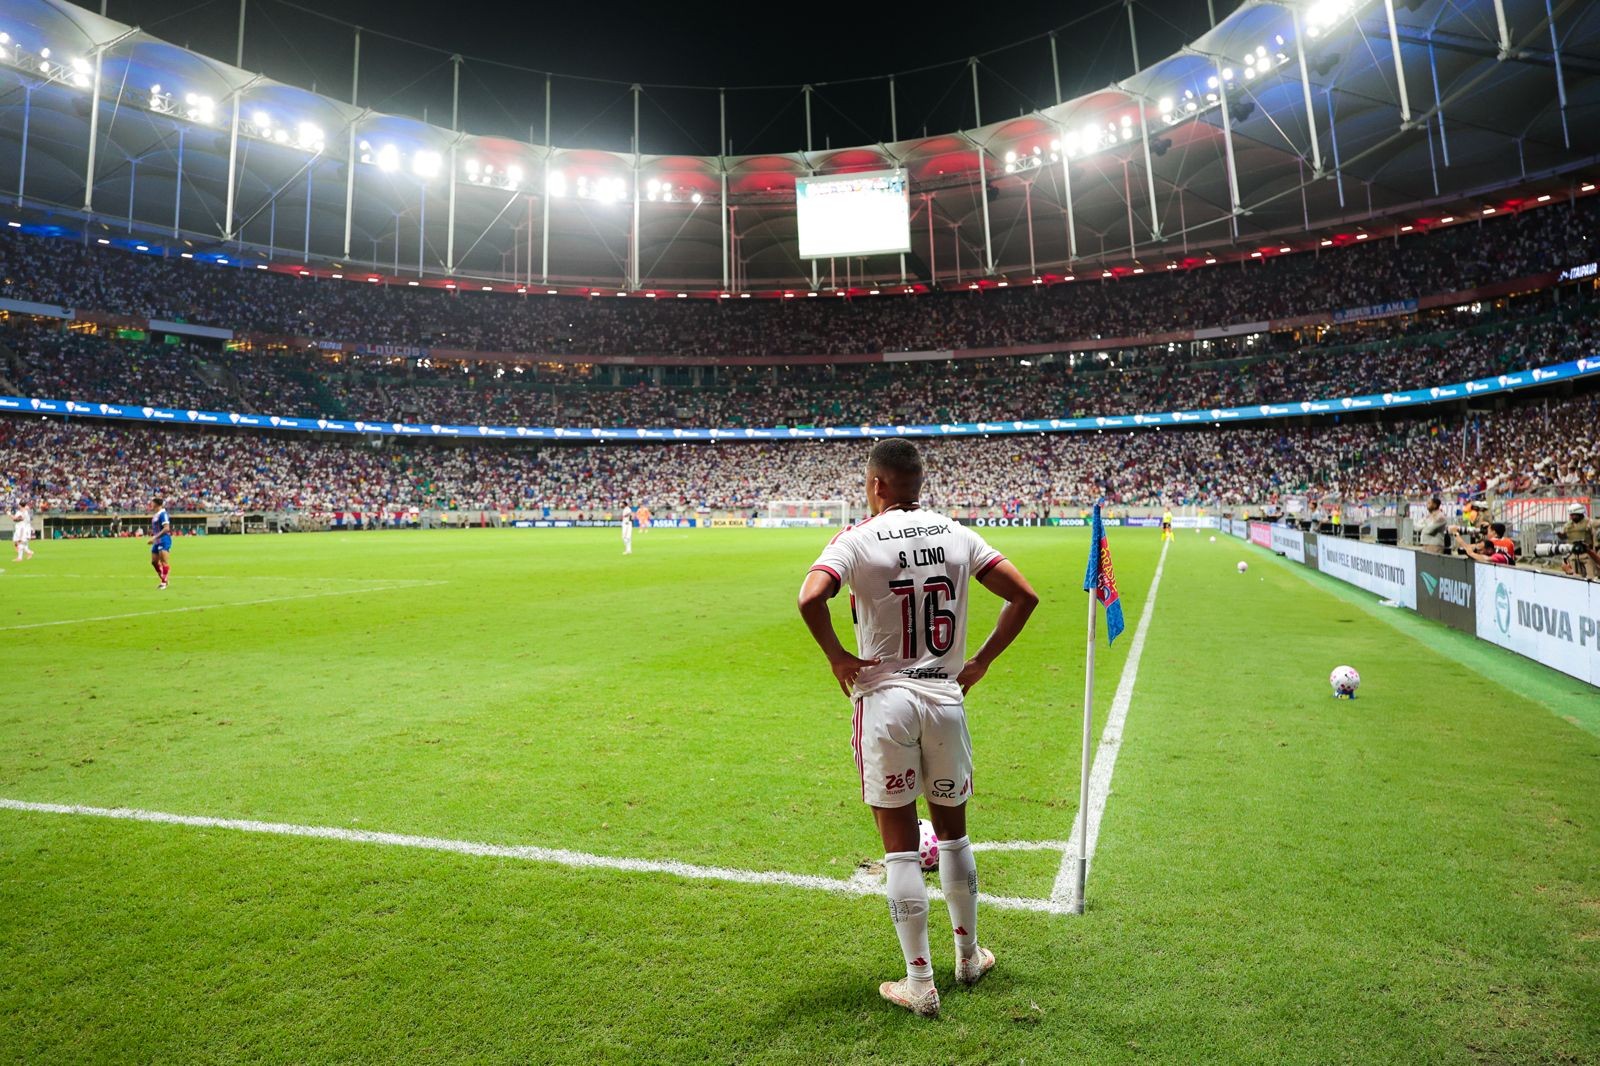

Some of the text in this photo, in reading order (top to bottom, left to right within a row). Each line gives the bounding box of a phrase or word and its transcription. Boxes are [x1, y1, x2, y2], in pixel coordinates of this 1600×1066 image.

[367, 344, 420, 356] LOUCOS
[1060, 518, 1084, 526] SICOOB
[1102, 518, 1120, 526] COOB
[899, 546, 945, 568] S. LINO
[1326, 548, 1338, 563] NOVA
[1351, 555, 1373, 576] MESMO
[1374, 562, 1405, 585] INSTINTO
[1439, 577, 1472, 608] PENALTY
[889, 576, 956, 659] 16
[1517, 599, 1574, 642] NOVA
[886, 773, 905, 790] Zé
